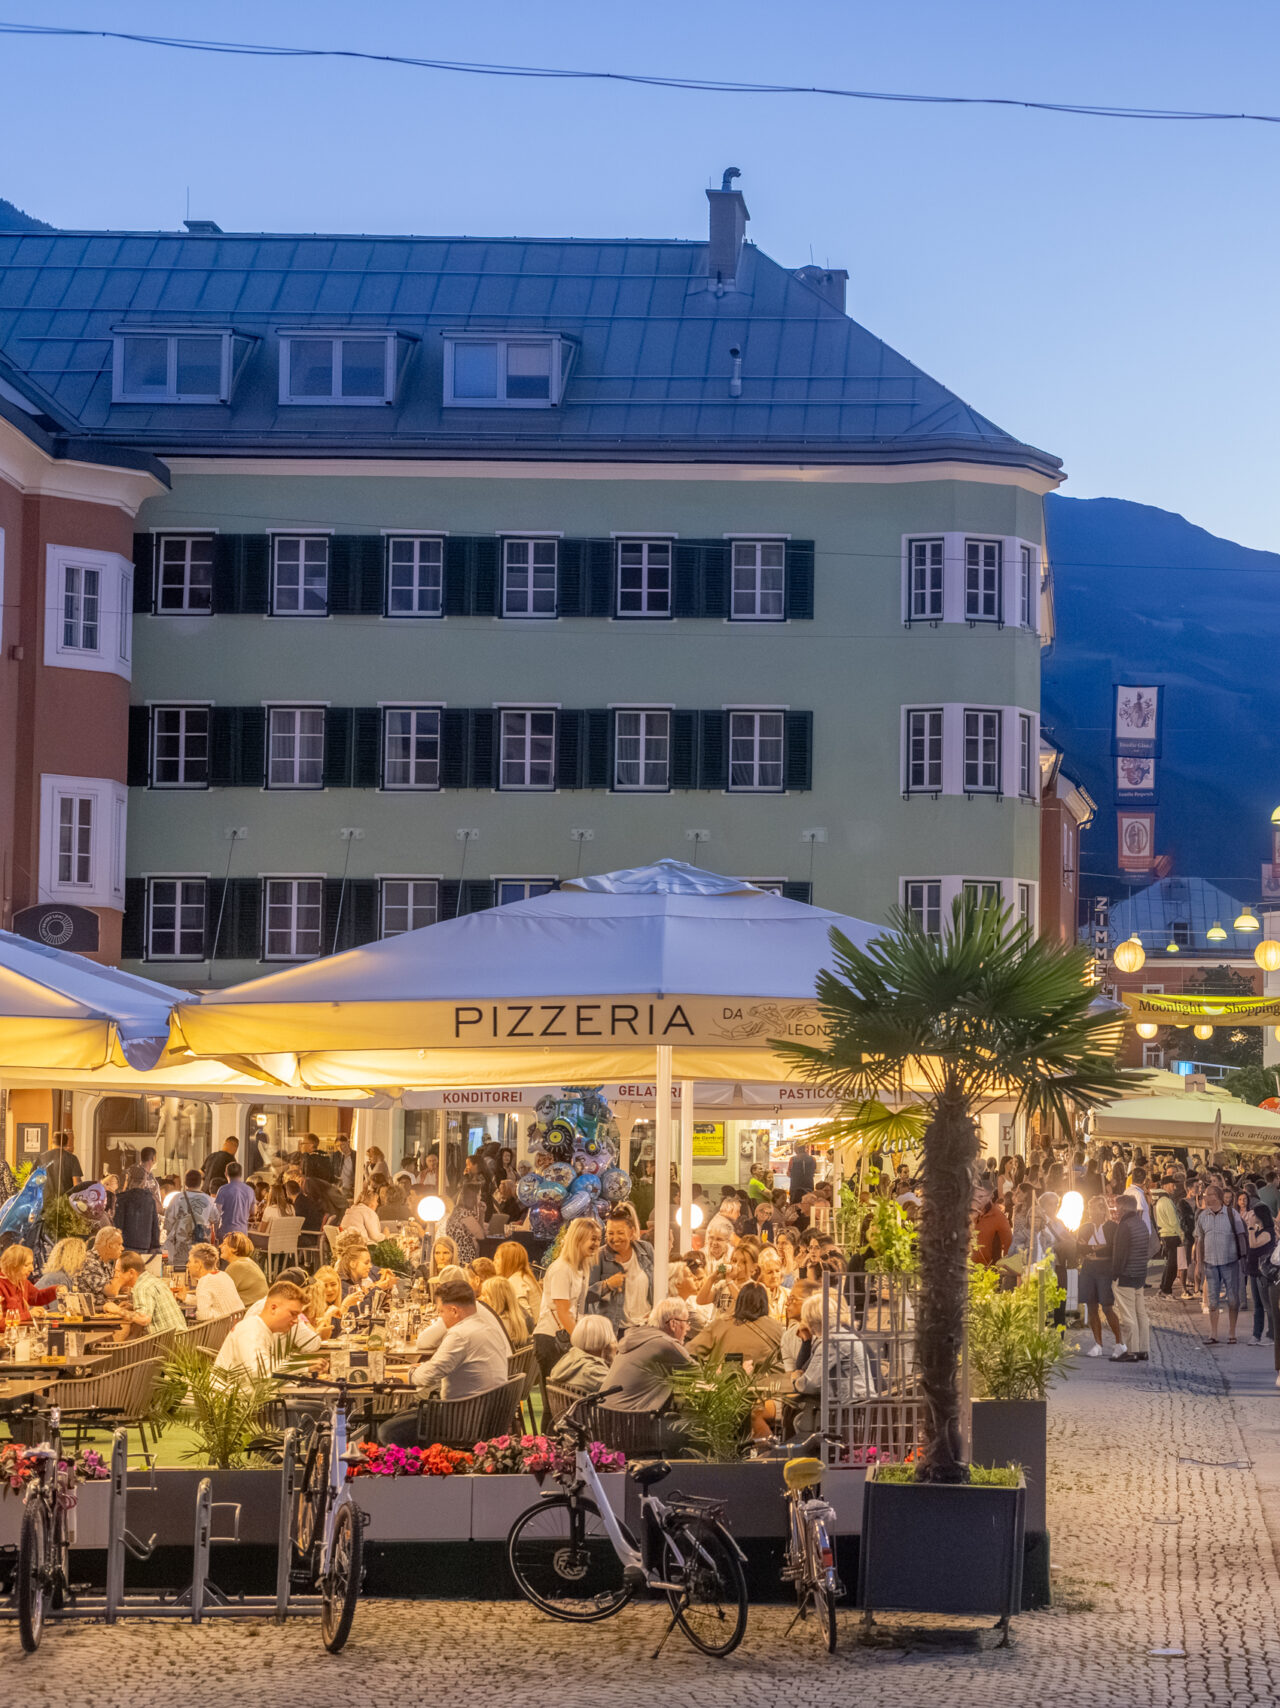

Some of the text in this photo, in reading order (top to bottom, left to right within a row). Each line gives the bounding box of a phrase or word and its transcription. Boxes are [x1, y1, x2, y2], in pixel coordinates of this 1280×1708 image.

[1095, 897, 1108, 993] ZIMME
[1138, 1000, 1280, 1016] Moonlight Shopping
[455, 1004, 827, 1037] PIZZERIA DA LEON
[442, 1091, 523, 1104] KONDITOREI
[618, 1085, 682, 1098] GELATRI
[779, 1088, 865, 1100] PASTICCERIA
[1221, 1126, 1244, 1138] elato
